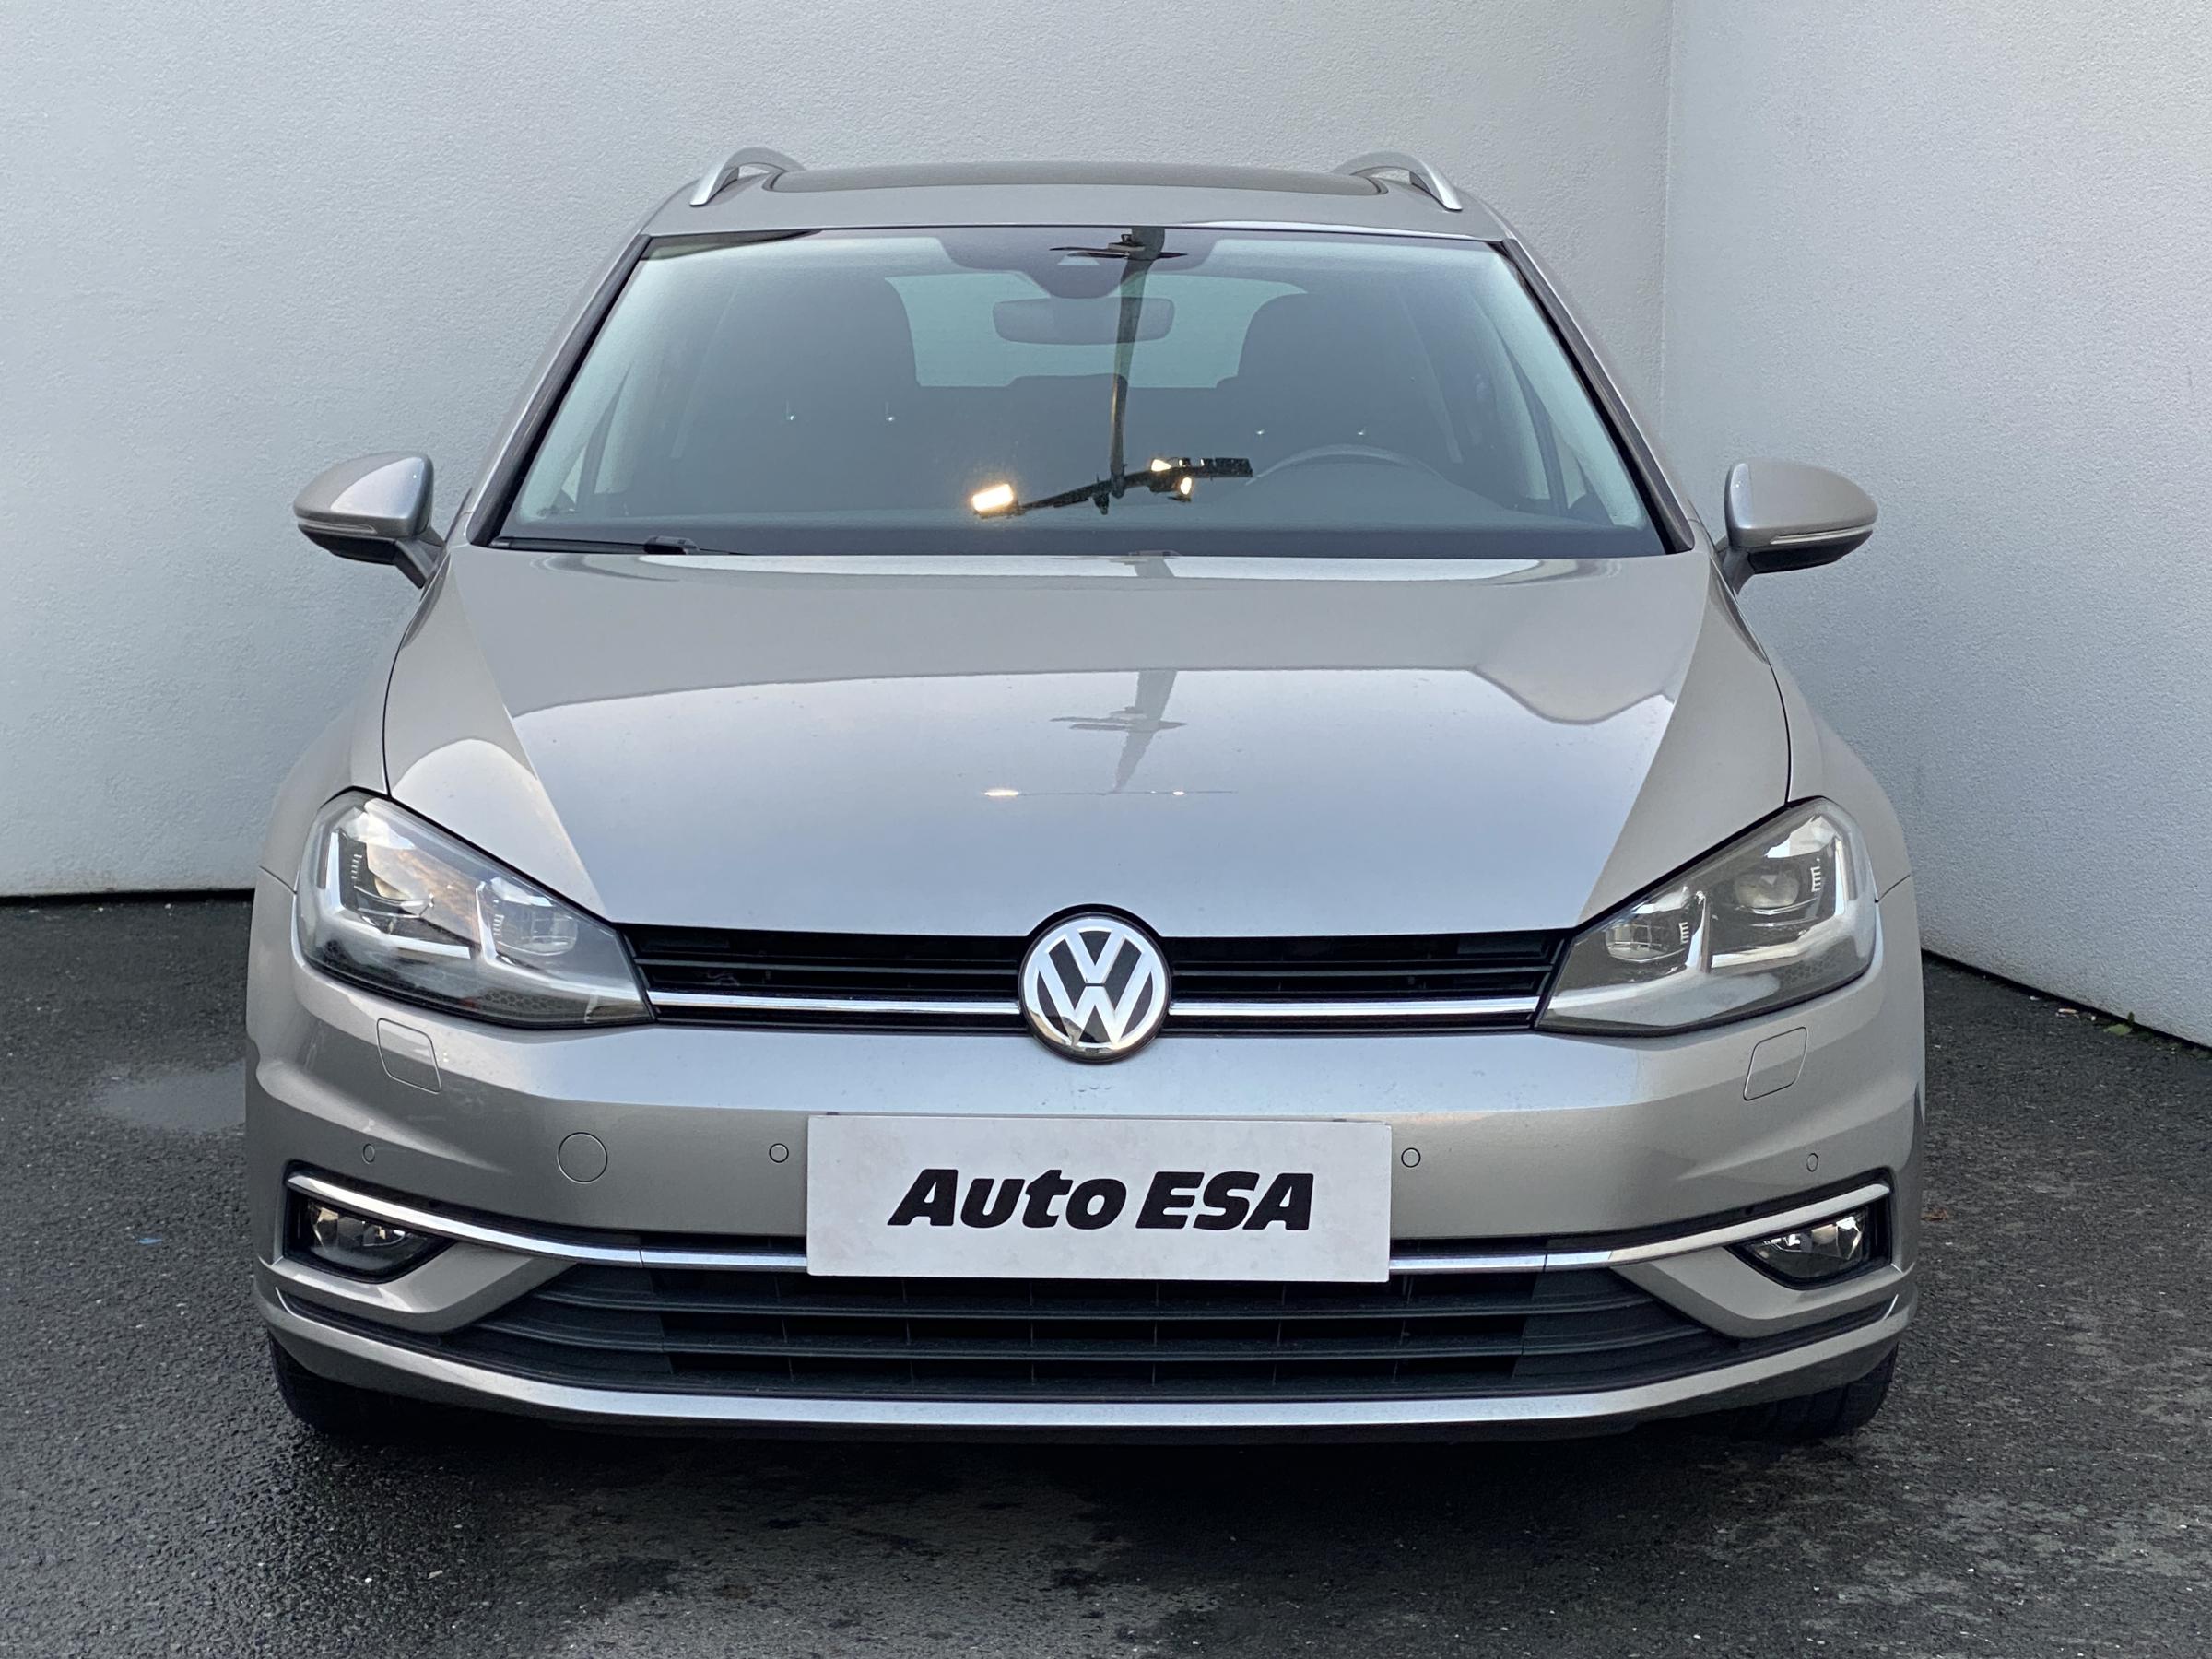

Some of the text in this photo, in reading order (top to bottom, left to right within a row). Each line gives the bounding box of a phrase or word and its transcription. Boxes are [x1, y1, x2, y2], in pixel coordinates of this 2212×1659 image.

[1027, 922, 1161, 1049] VW
[887, 1169, 1314, 1231] Auto ESA
